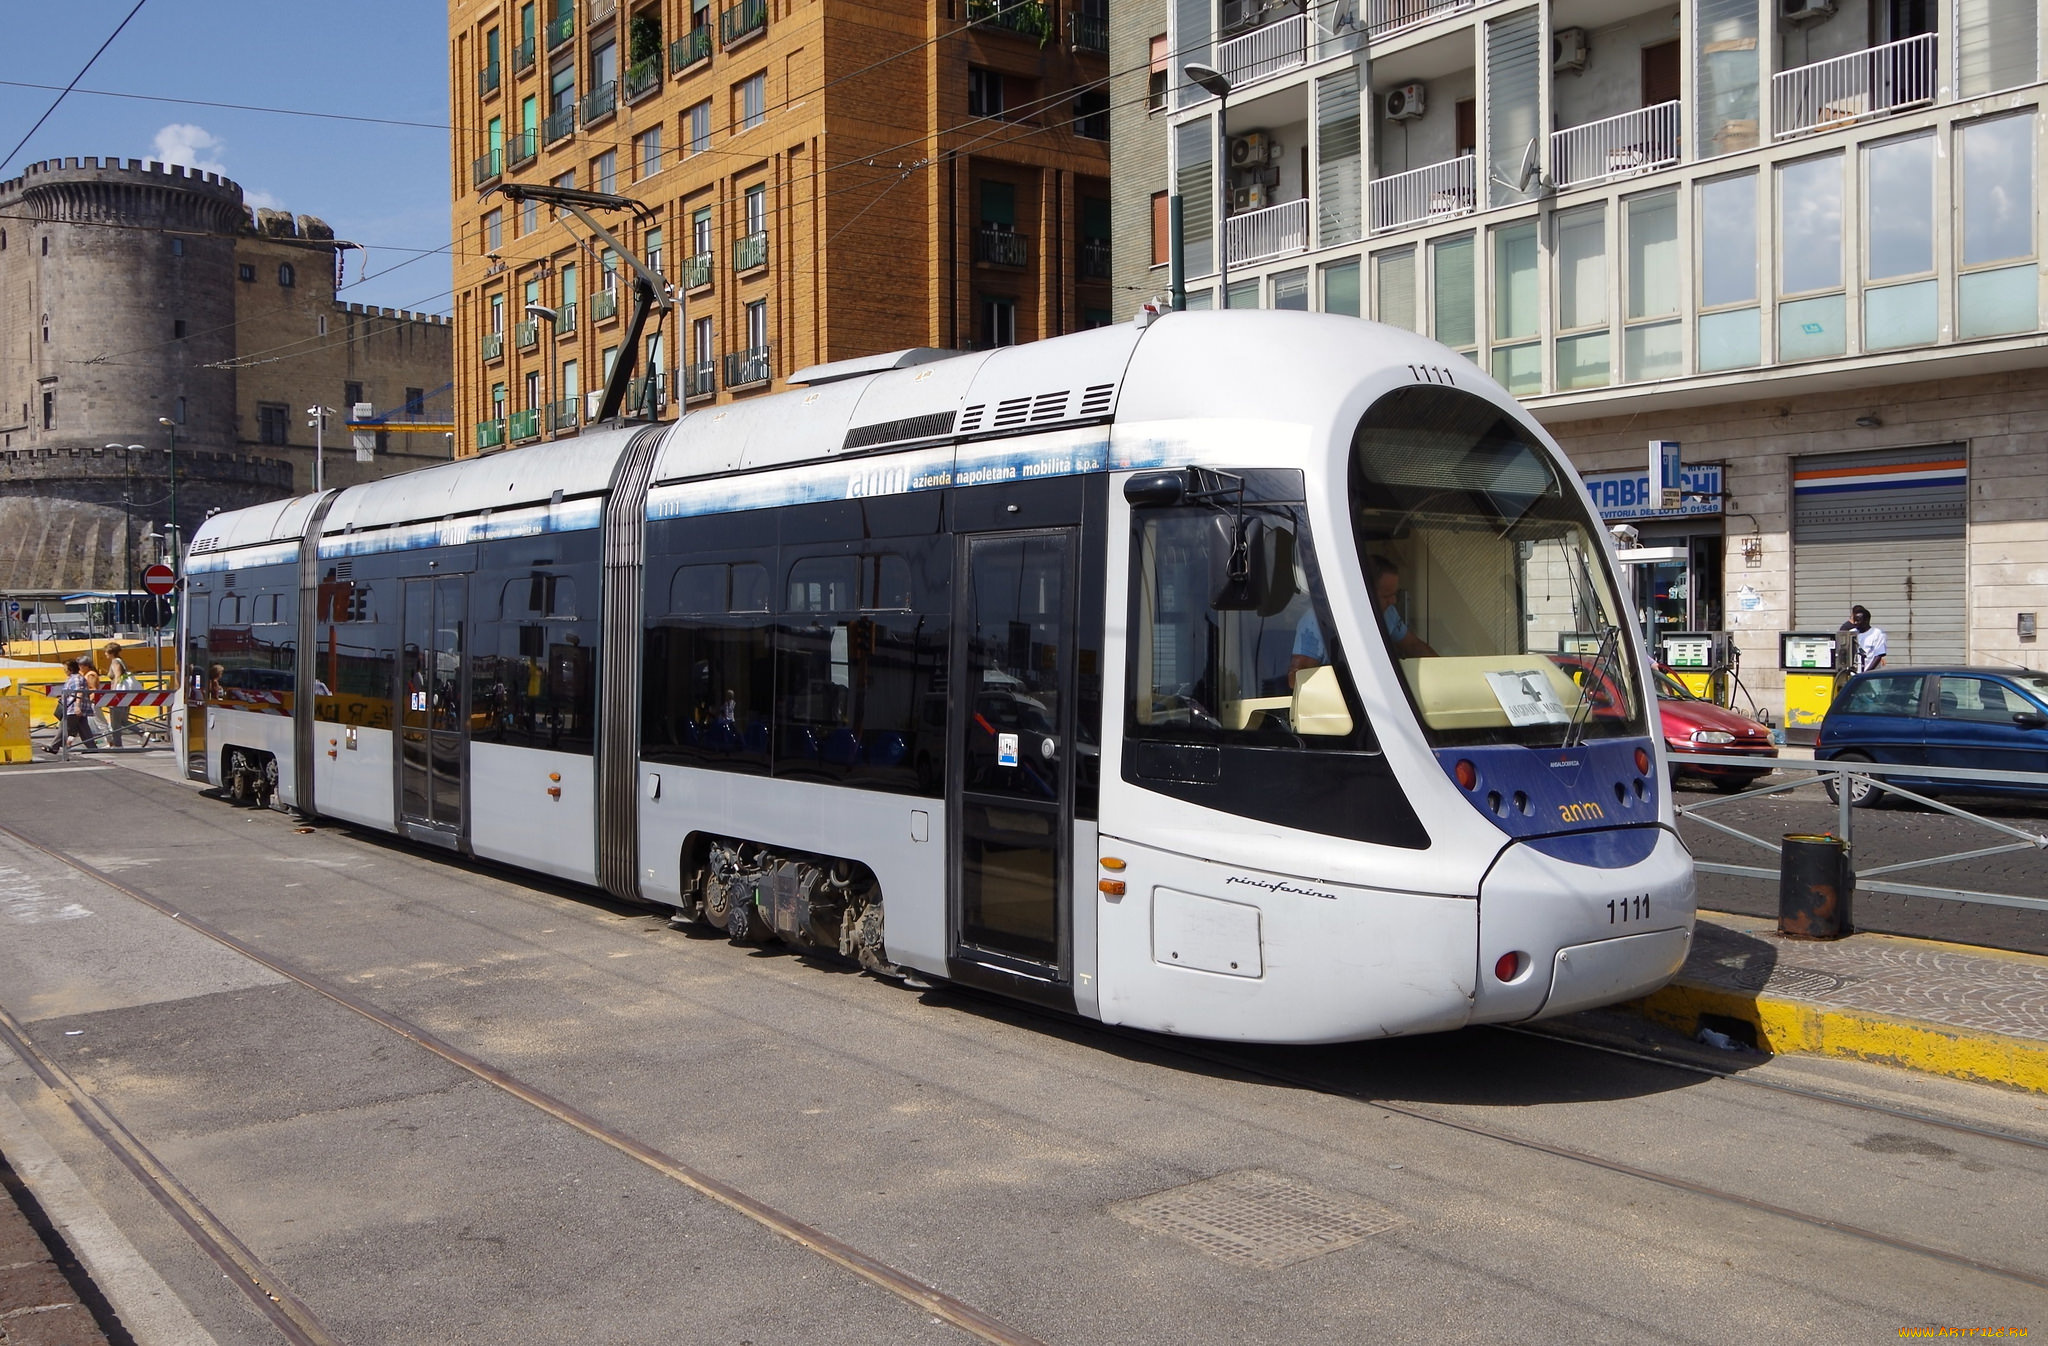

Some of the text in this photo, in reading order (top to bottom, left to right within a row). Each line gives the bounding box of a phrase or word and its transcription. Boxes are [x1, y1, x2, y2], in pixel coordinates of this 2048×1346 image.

[1408, 364, 1455, 386] 1111
[912, 471, 952, 489] azienda
[956, 466, 1016, 485] napoletana
[1022, 457, 1071, 476] mobilità
[1076, 459, 1100, 472] s.p.a.
[1587, 472, 1718, 508] TABACHI
[1521, 677, 1542, 702] 4
[1558, 801, 1605, 823] anm
[1225, 876, 1338, 900] pininfarina
[1606, 893, 1650, 925] 1111
